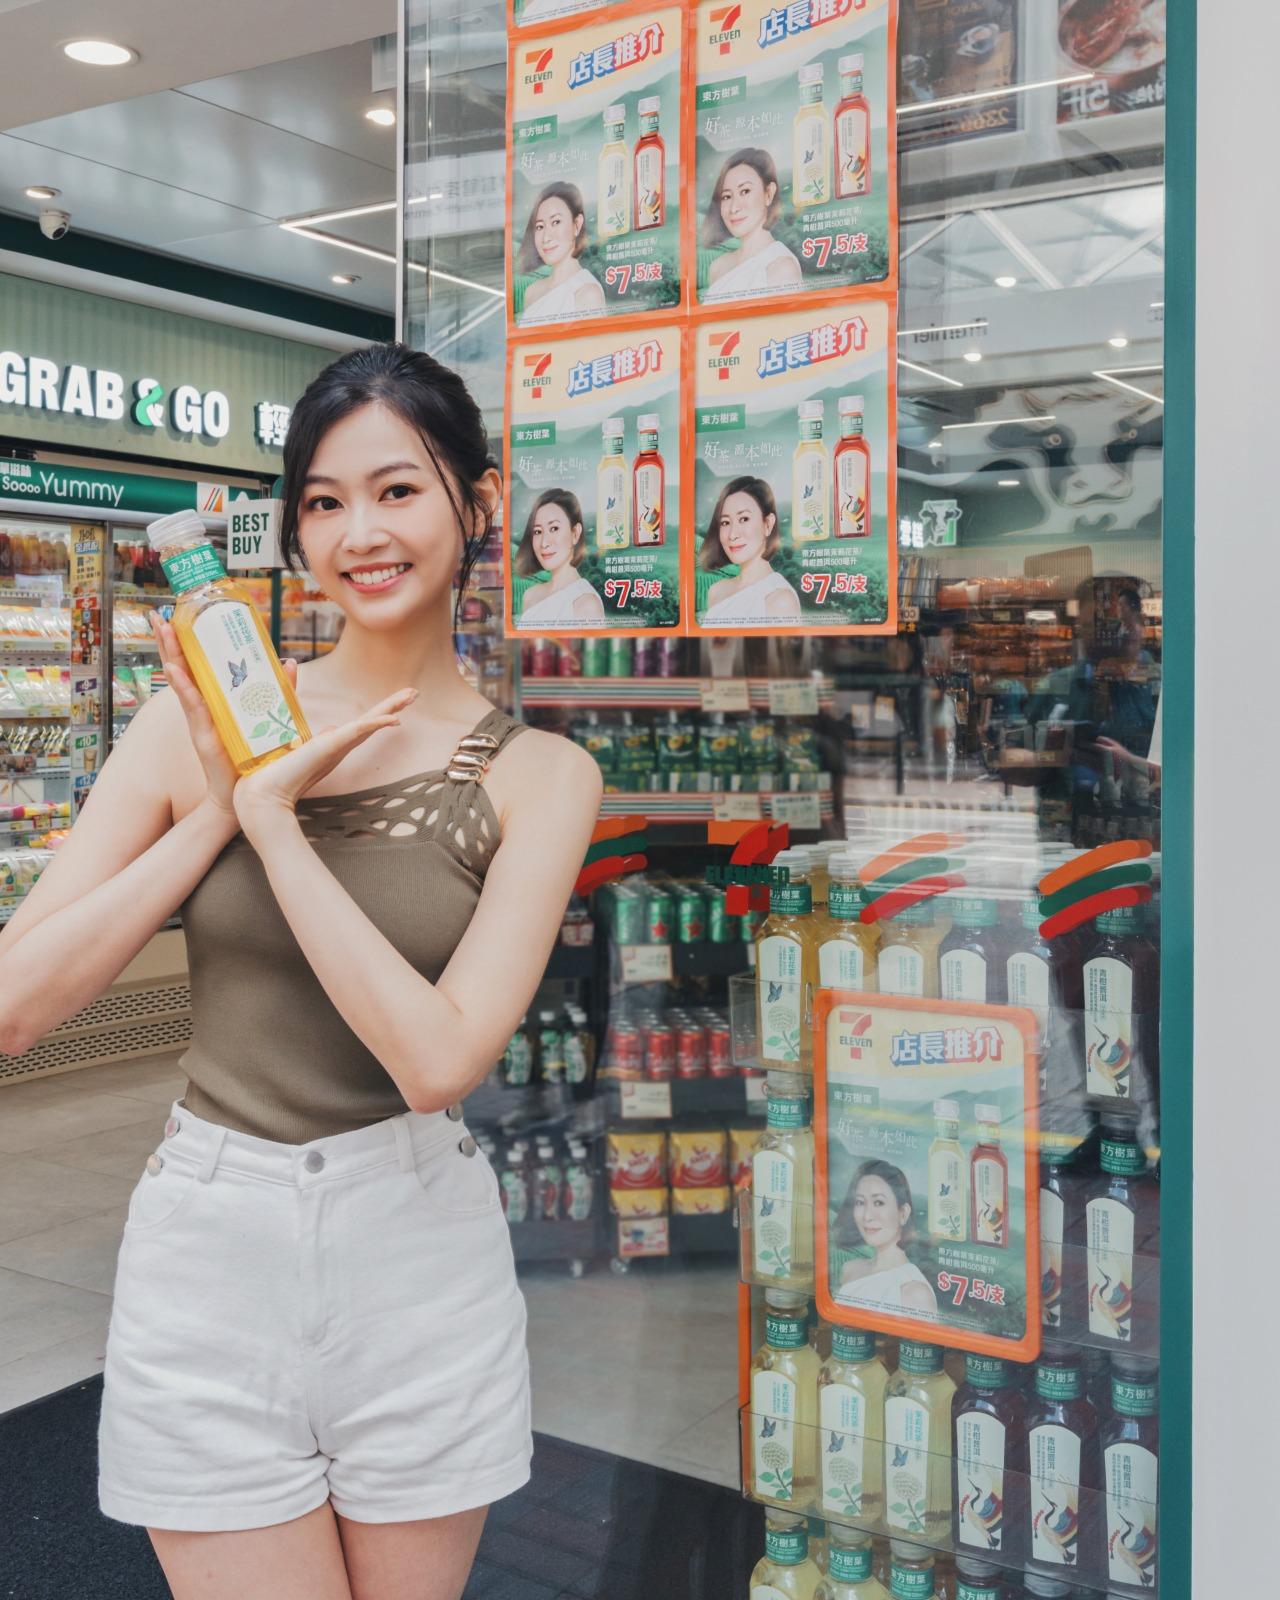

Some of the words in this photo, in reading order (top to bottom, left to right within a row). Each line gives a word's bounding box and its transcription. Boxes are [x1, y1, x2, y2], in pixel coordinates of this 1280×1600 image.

[709, 4, 742, 55] 7
[526, 48, 553, 95] 7
[567, 22, 664, 90] 店長推介
[703, 86, 740, 102] 東方樹葉
[566, 339, 663, 399] 店長推介
[708, 331, 741, 380] 7
[756, 316, 868, 379] 店長推介
[0, 351, 124, 420] GRAB
[135, 378, 164, 427] &
[174, 385, 230, 438] GO
[524, 353, 552, 399] 7
[516, 429, 550, 441] 東方樹葉
[701, 412, 739, 425] 東方樹葉
[40, 472, 124, 506] Yummy
[232, 512, 270, 533] BEST
[232, 536, 262, 555] BUY
[169, 550, 214, 575] 東方樹葉
[839, 1011, 873, 1060] 7
[890, 1026, 1004, 1067] 店長推介
